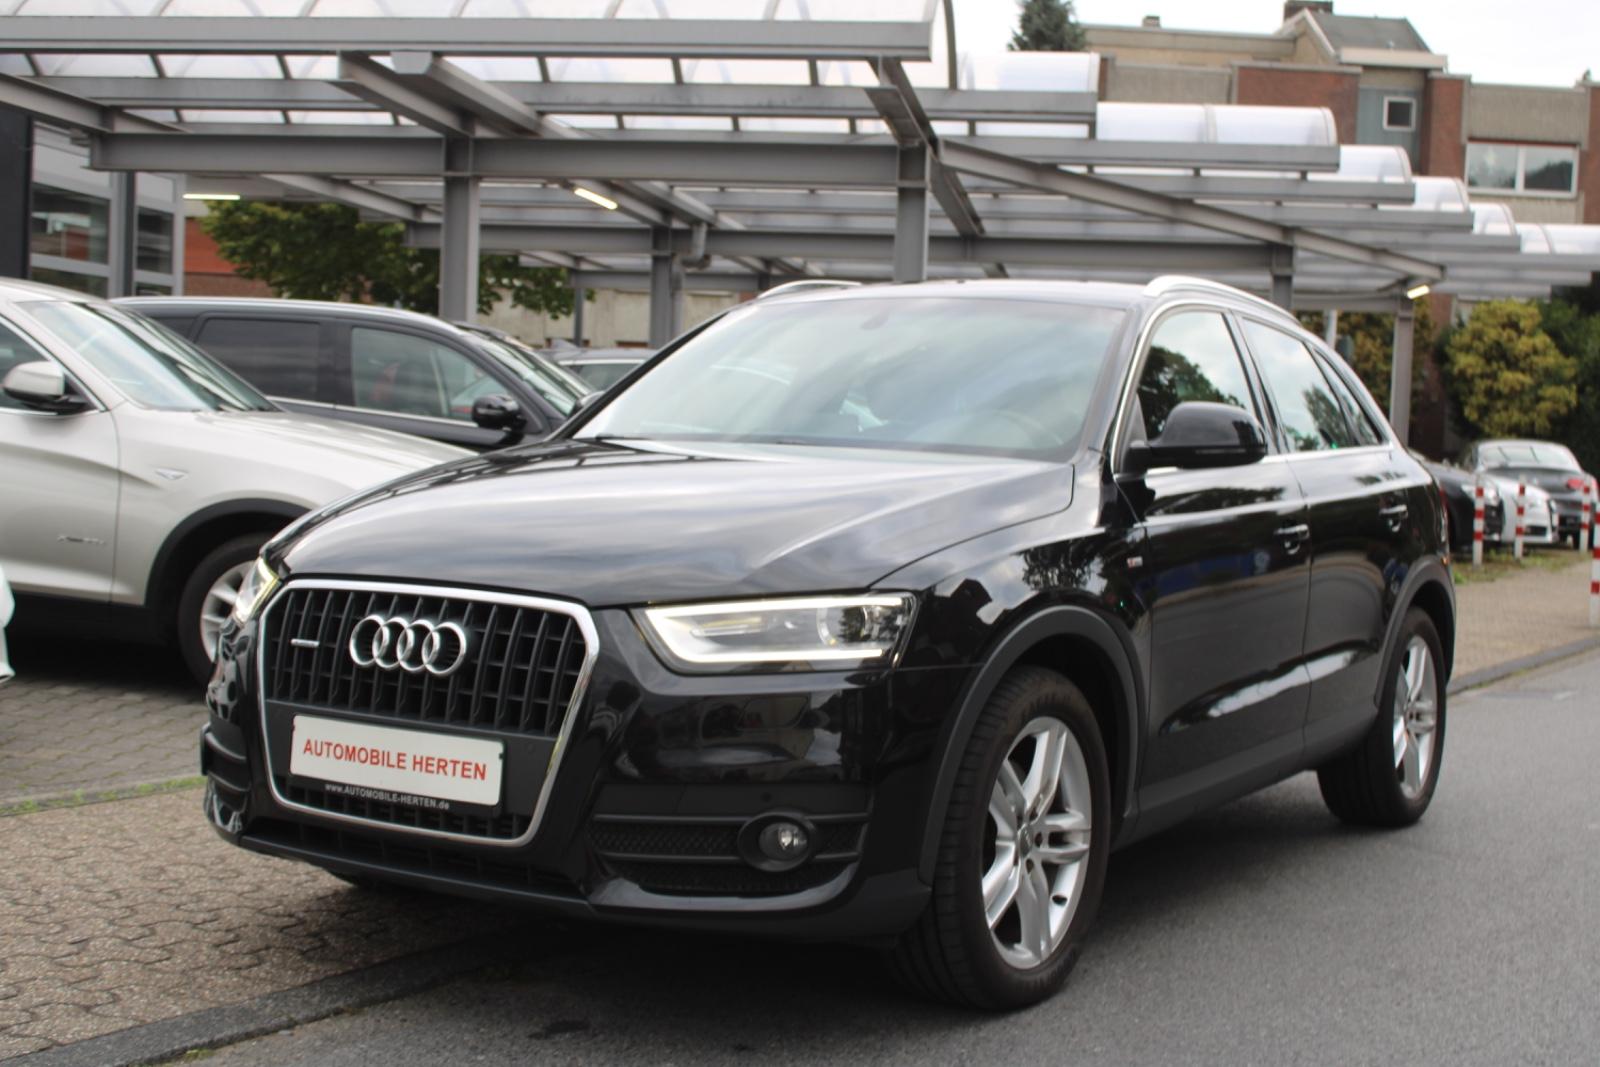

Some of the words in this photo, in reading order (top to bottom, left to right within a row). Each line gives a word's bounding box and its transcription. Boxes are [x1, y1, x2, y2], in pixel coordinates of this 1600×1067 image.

[303, 739, 407, 770] AUTOMOBILE
[412, 755, 487, 781] HERTEN
[325, 783, 450, 810] www.AUTOMOBILE-HERTEN.de
